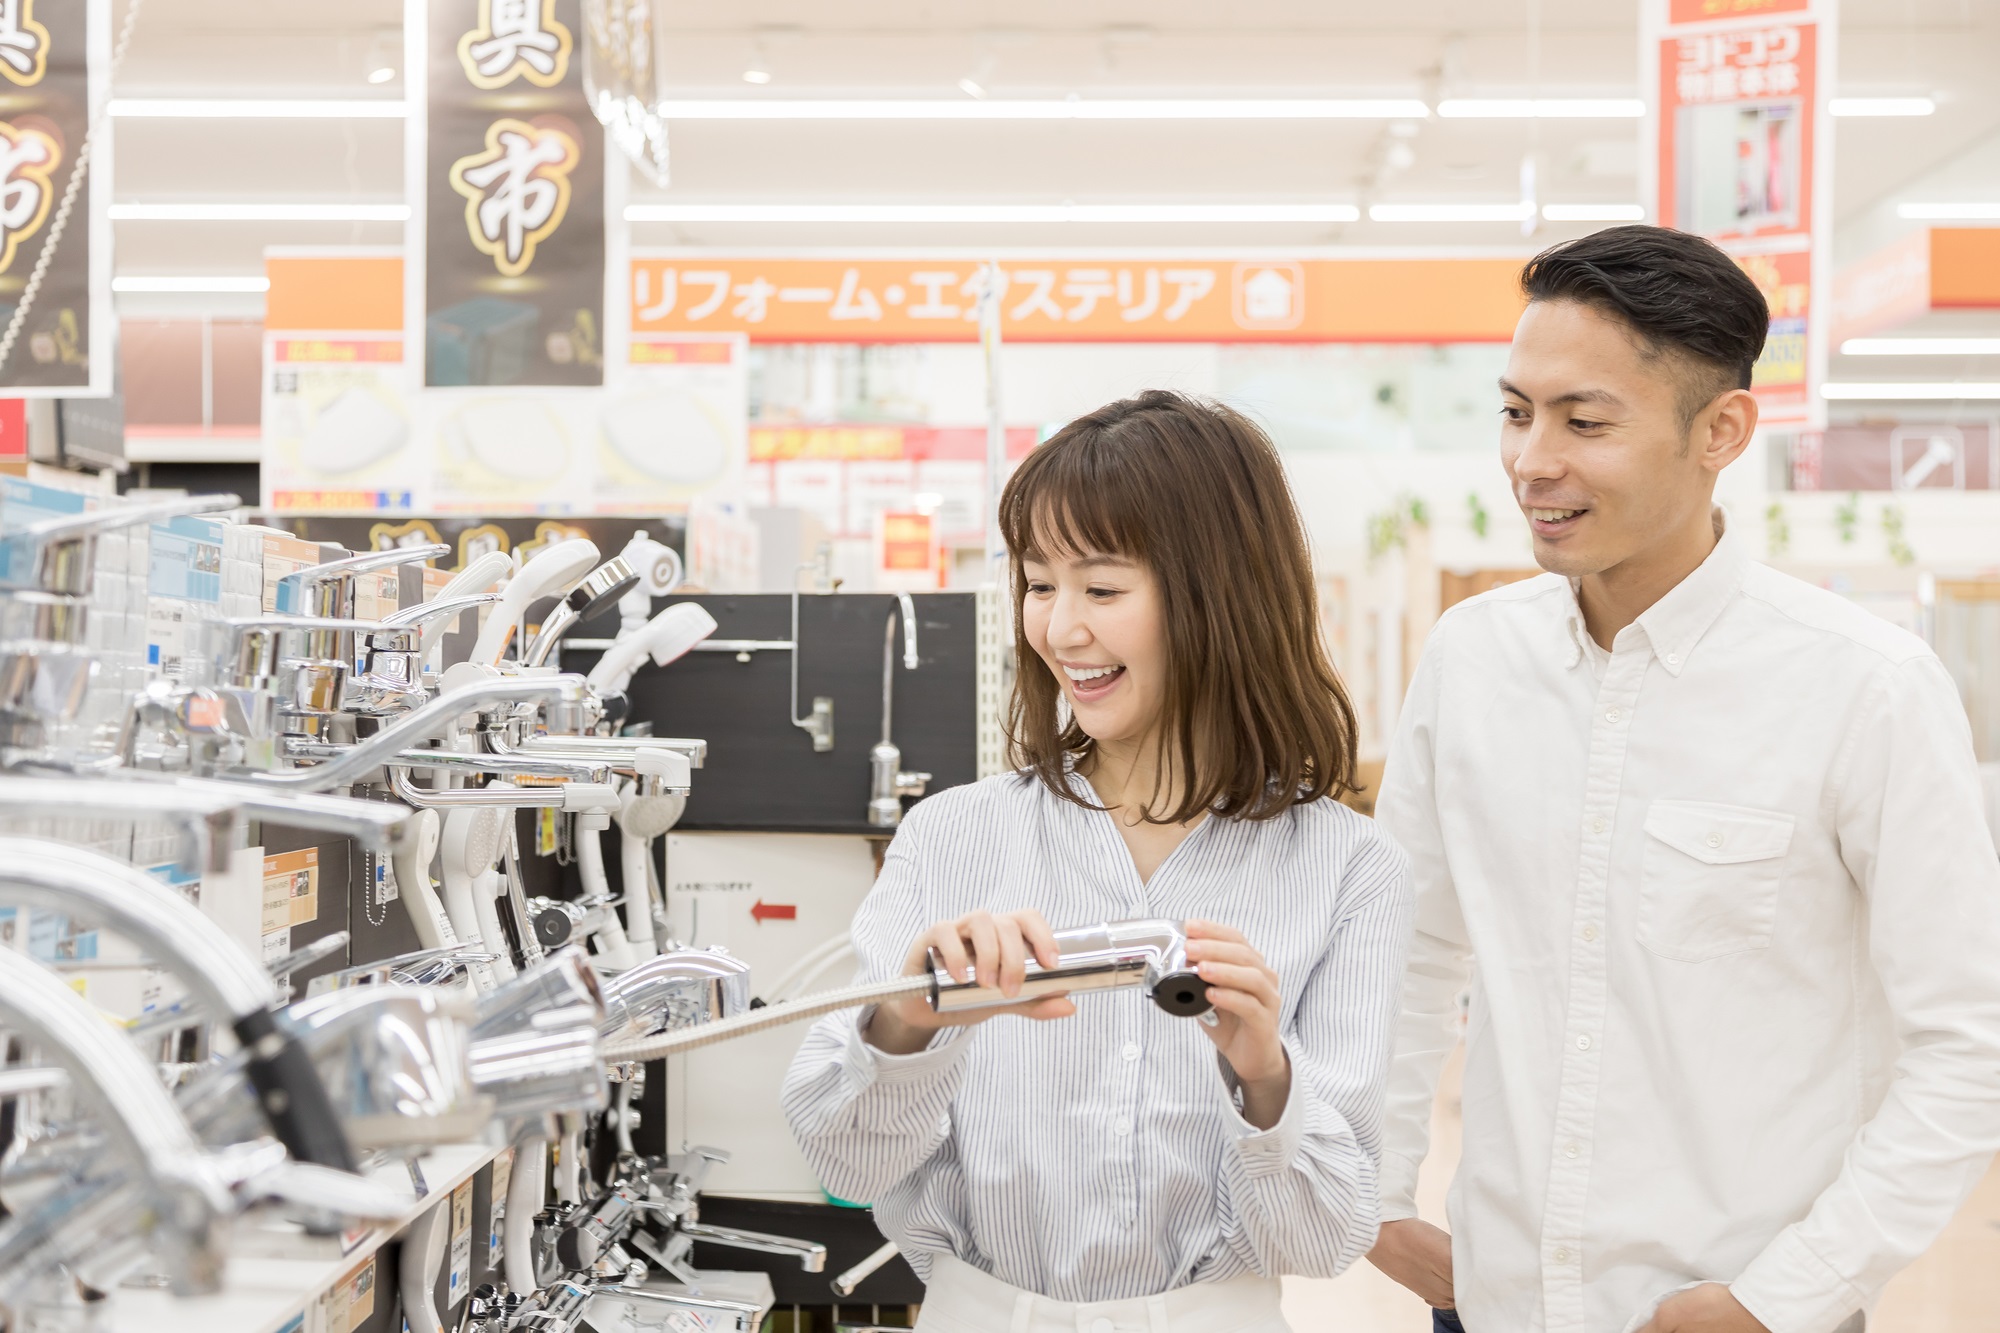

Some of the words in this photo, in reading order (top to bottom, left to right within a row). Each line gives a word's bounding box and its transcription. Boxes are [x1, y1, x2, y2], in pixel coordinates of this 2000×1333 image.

[634, 266, 1217, 322] リフォーム・エクステリア
